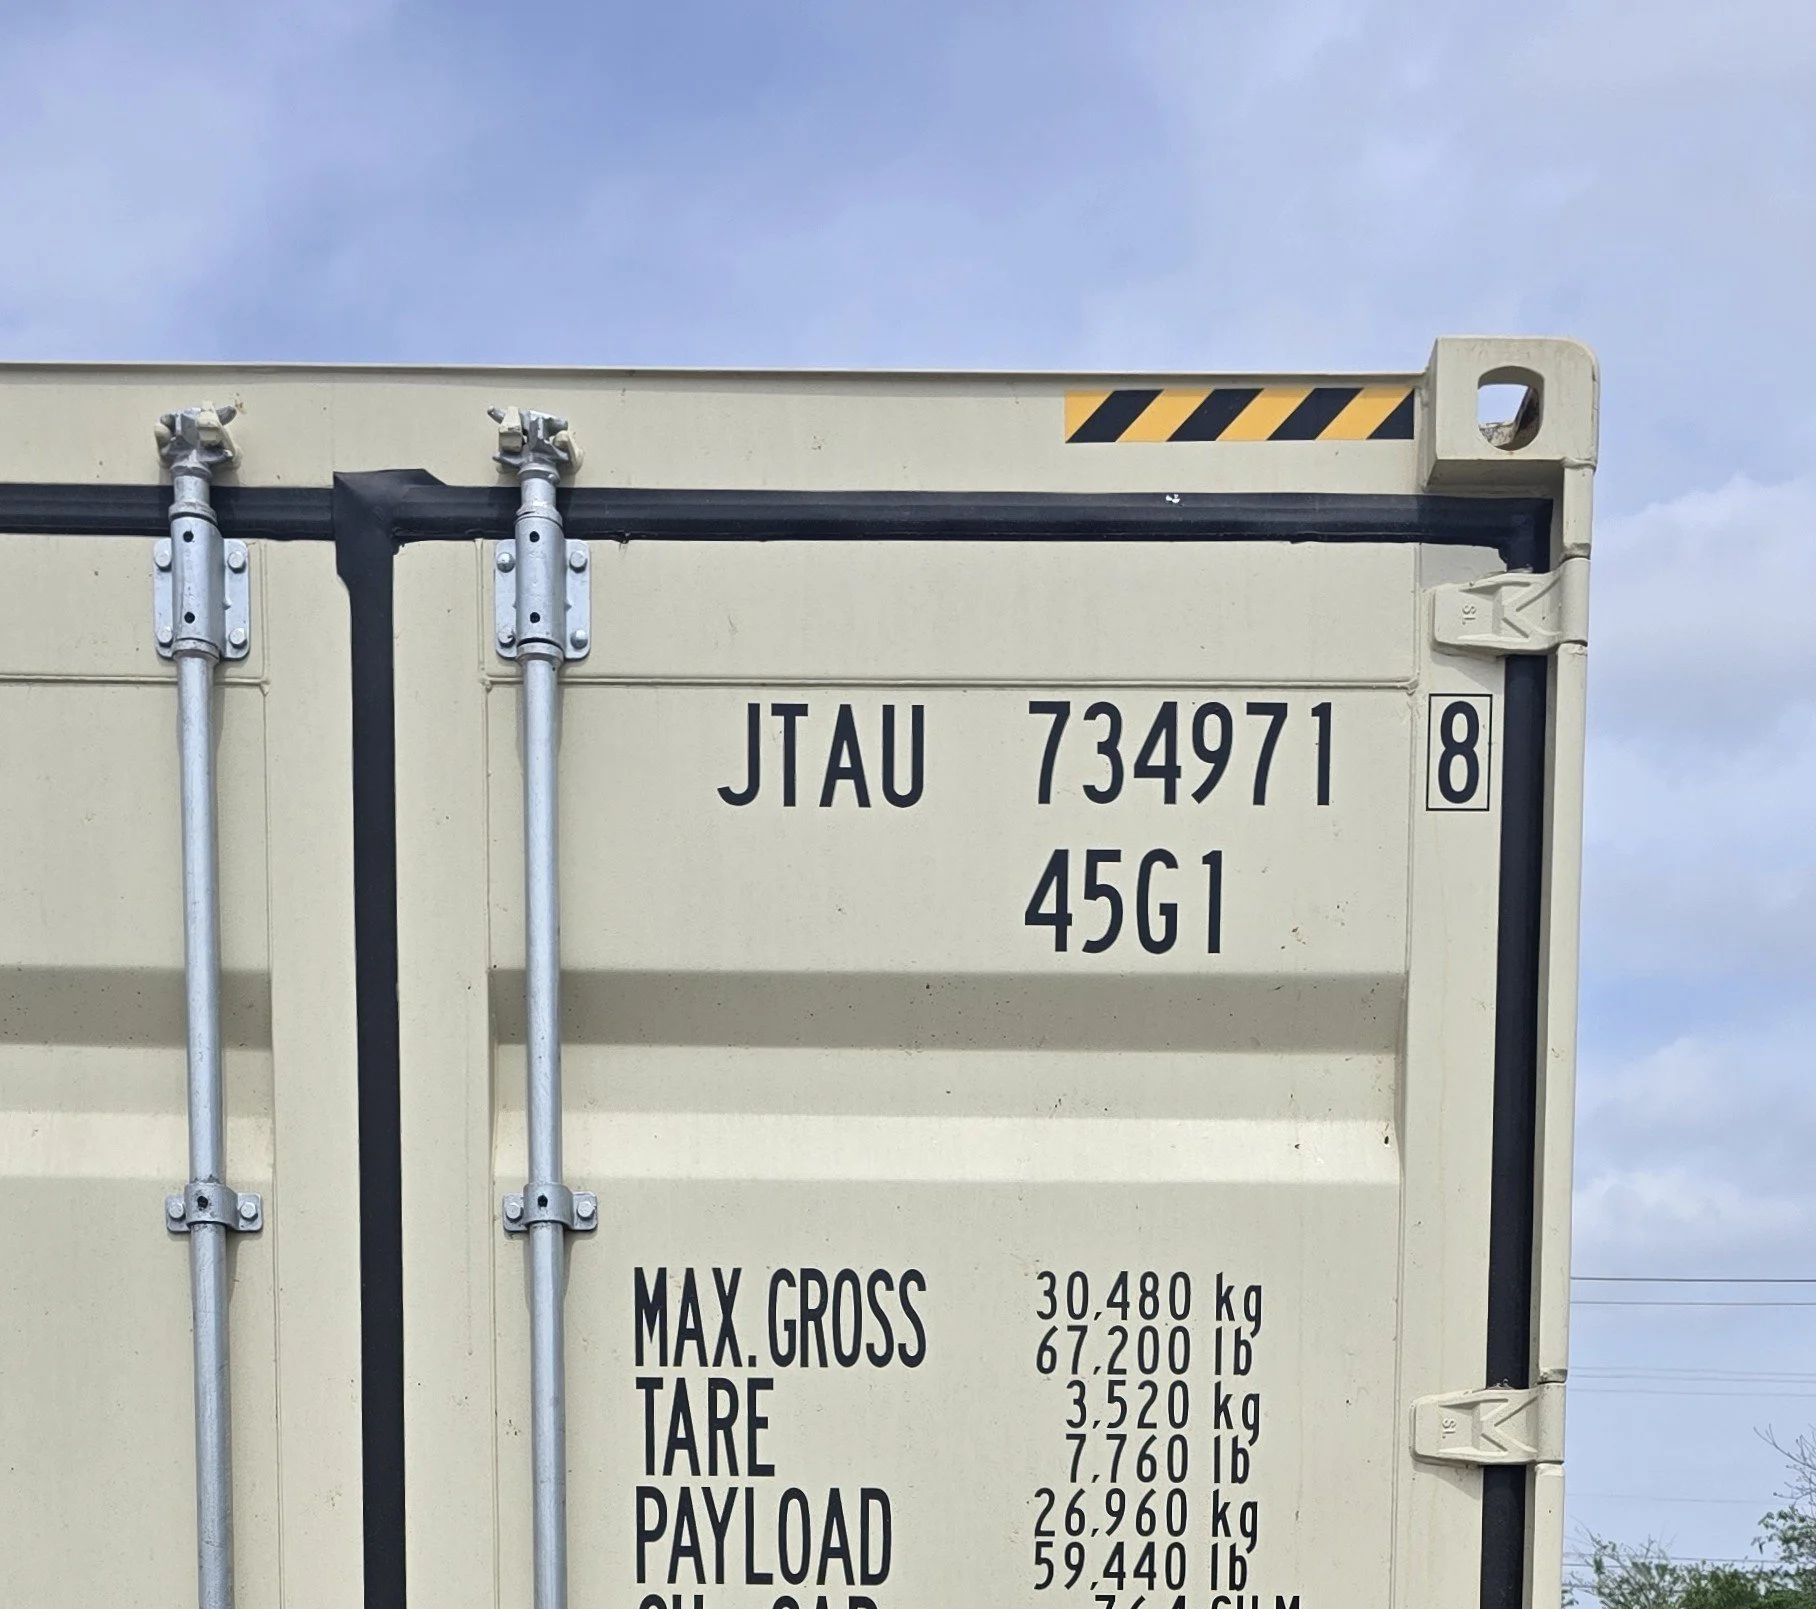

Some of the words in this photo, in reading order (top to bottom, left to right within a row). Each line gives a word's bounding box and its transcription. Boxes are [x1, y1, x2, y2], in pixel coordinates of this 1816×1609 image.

[717, 702, 925, 808] JTAU
[1028, 700, 1332, 806] 734971
[1437, 700, 1480, 804] 8
[1024, 848, 1223, 955] 45G1
[1036, 1270, 1192, 1321] 30,480
[1215, 1270, 1262, 1339] kg
[1036, 1325, 1191, 1375] 67,200
[1214, 1326, 1252, 1376] lb
[635, 1376, 775, 1477] TARE
[1066, 1379, 1190, 1430] 3,520
[1213, 1380, 1260, 1447] kg
[1065, 1433, 1189, 1484] 7,760
[1213, 1434, 1250, 1485] lb
[635, 1485, 892, 1586] PAYLOAD
[1034, 1487, 1188, 1538] 26,960
[1211, 1488, 1258, 1554] kg
[1033, 1541, 1187, 1591] 59,440
[1210, 1542, 1248, 1592] lb
